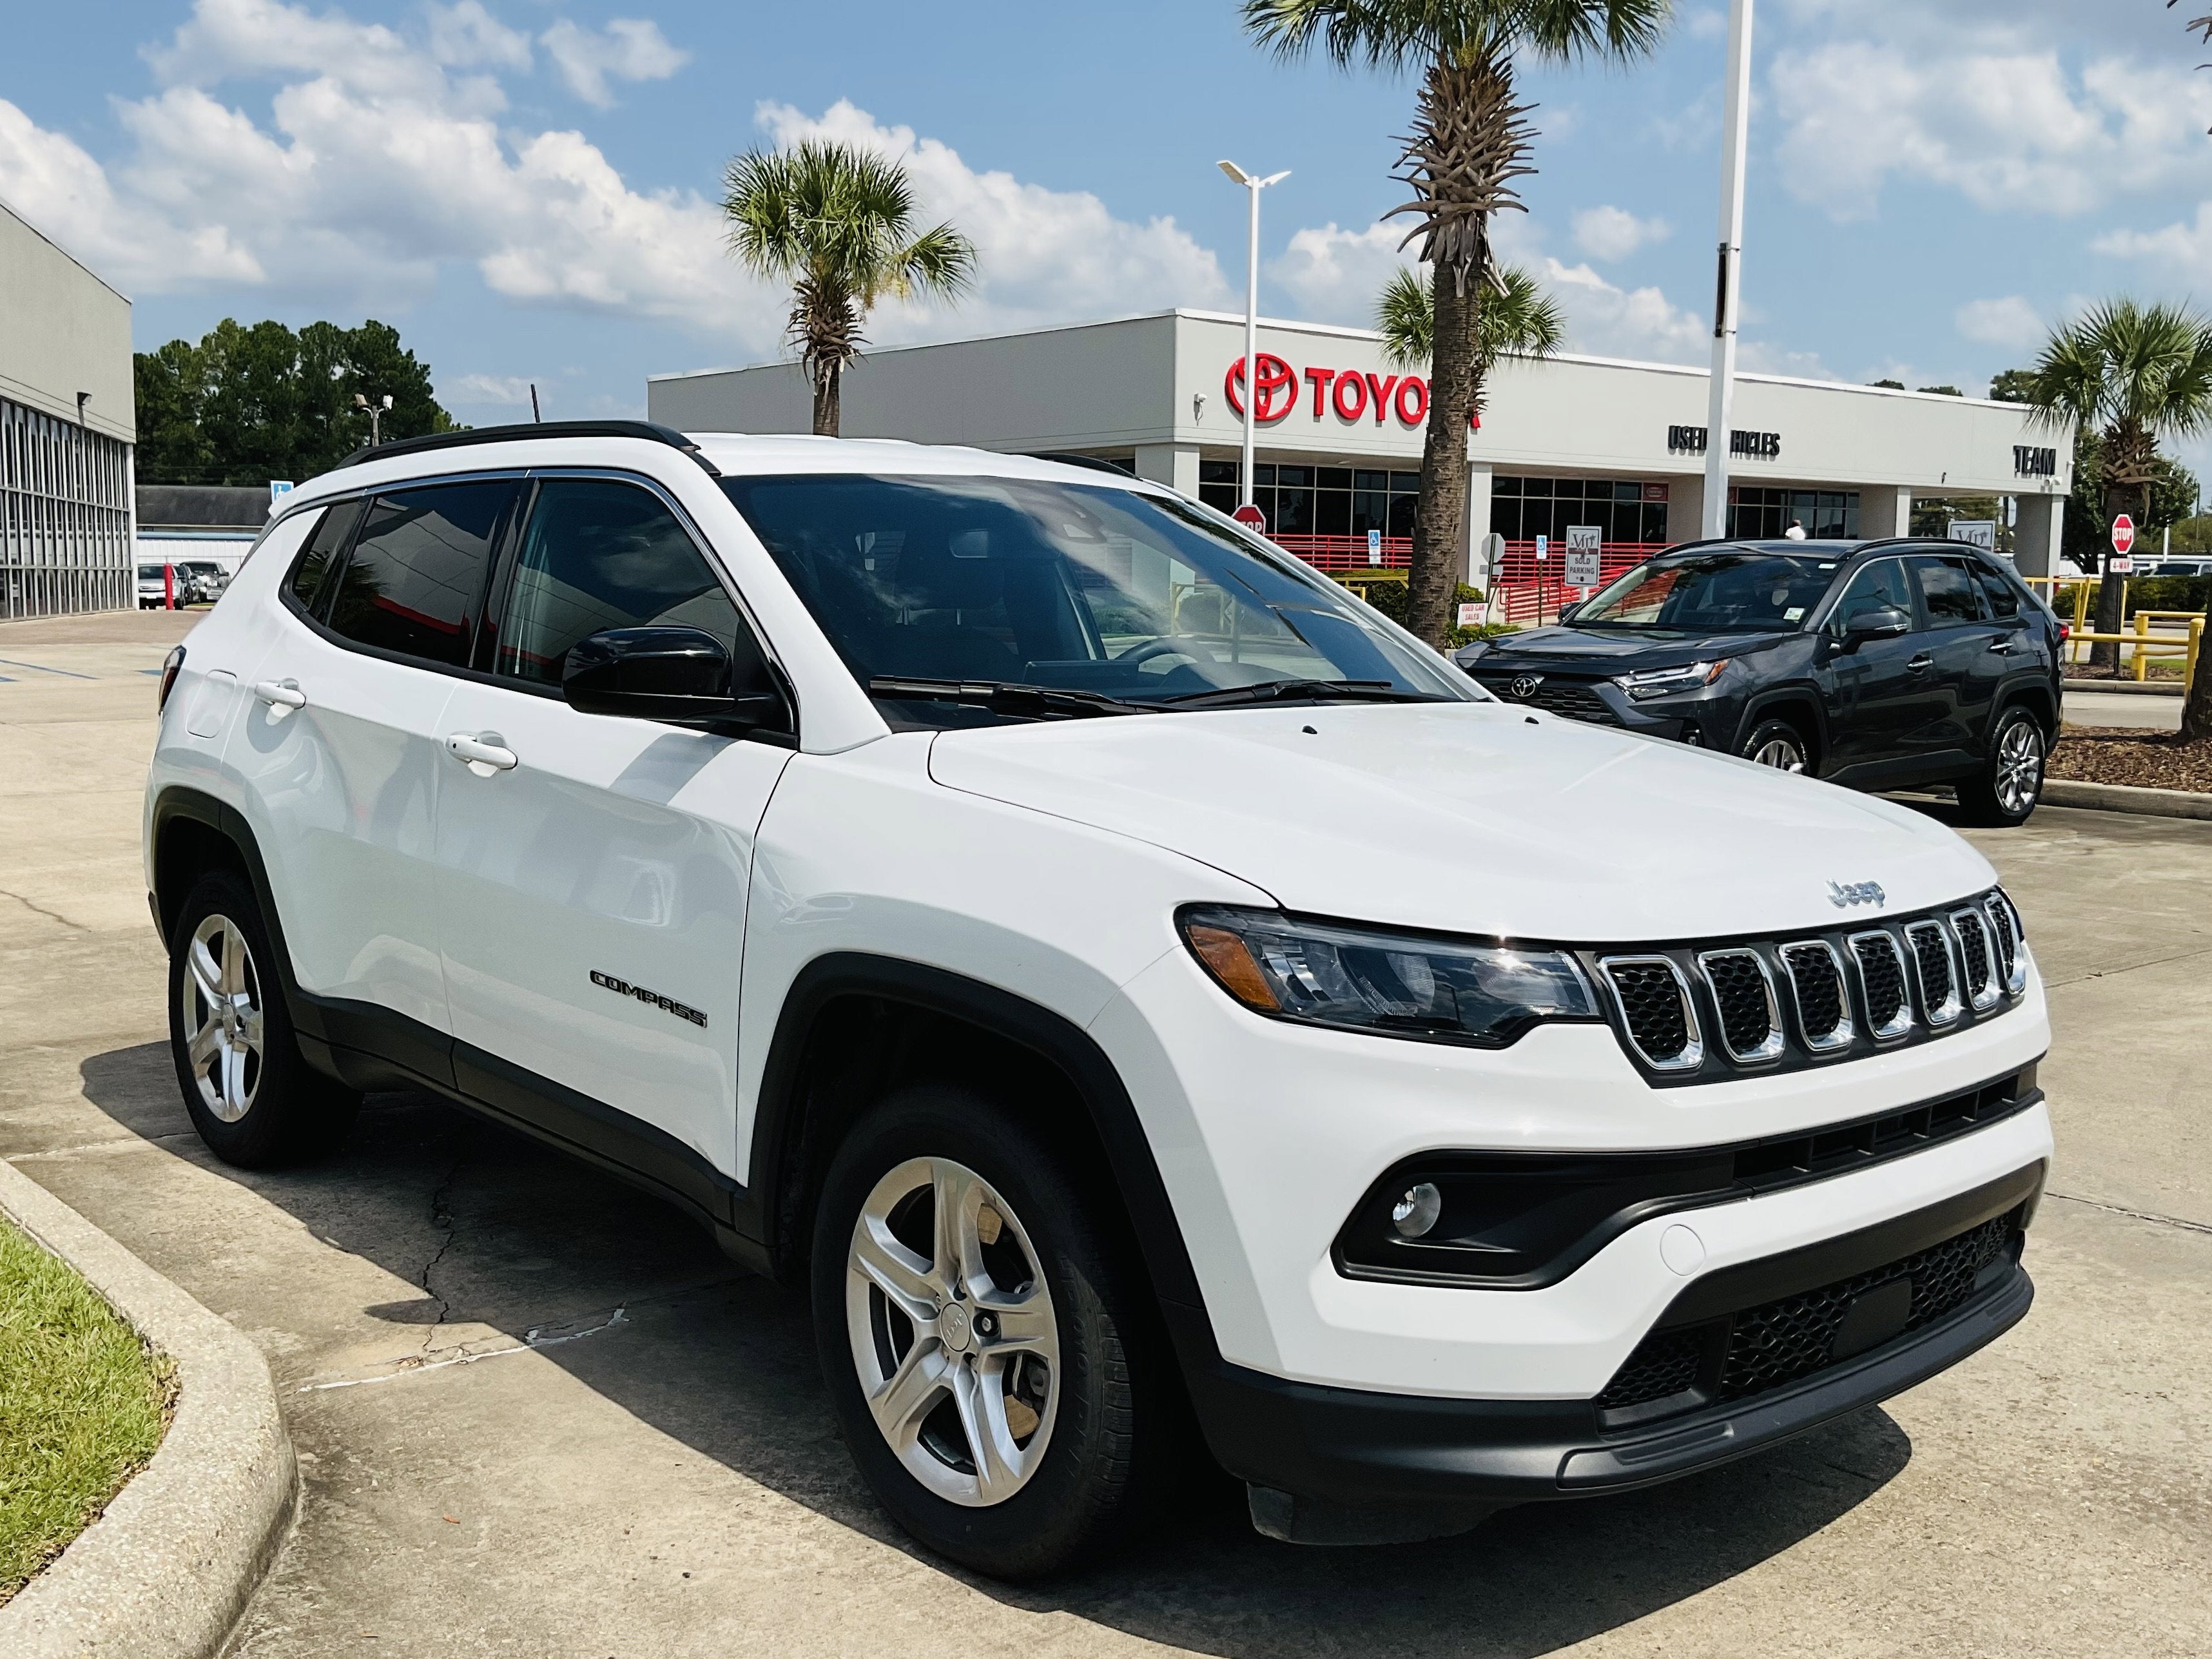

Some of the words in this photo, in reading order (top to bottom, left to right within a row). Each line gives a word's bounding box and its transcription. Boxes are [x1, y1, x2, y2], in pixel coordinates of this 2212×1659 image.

[1305, 367, 1480, 428] TOYO
[1729, 430, 1780, 456] HICLES
[2013, 445, 2056, 475] TEAM
[1239, 521, 1263, 532] OP
[2114, 527, 2131, 541] STOP
[1825, 877, 1885, 908] Jeep
[590, 968, 708, 1028] COMPASS
